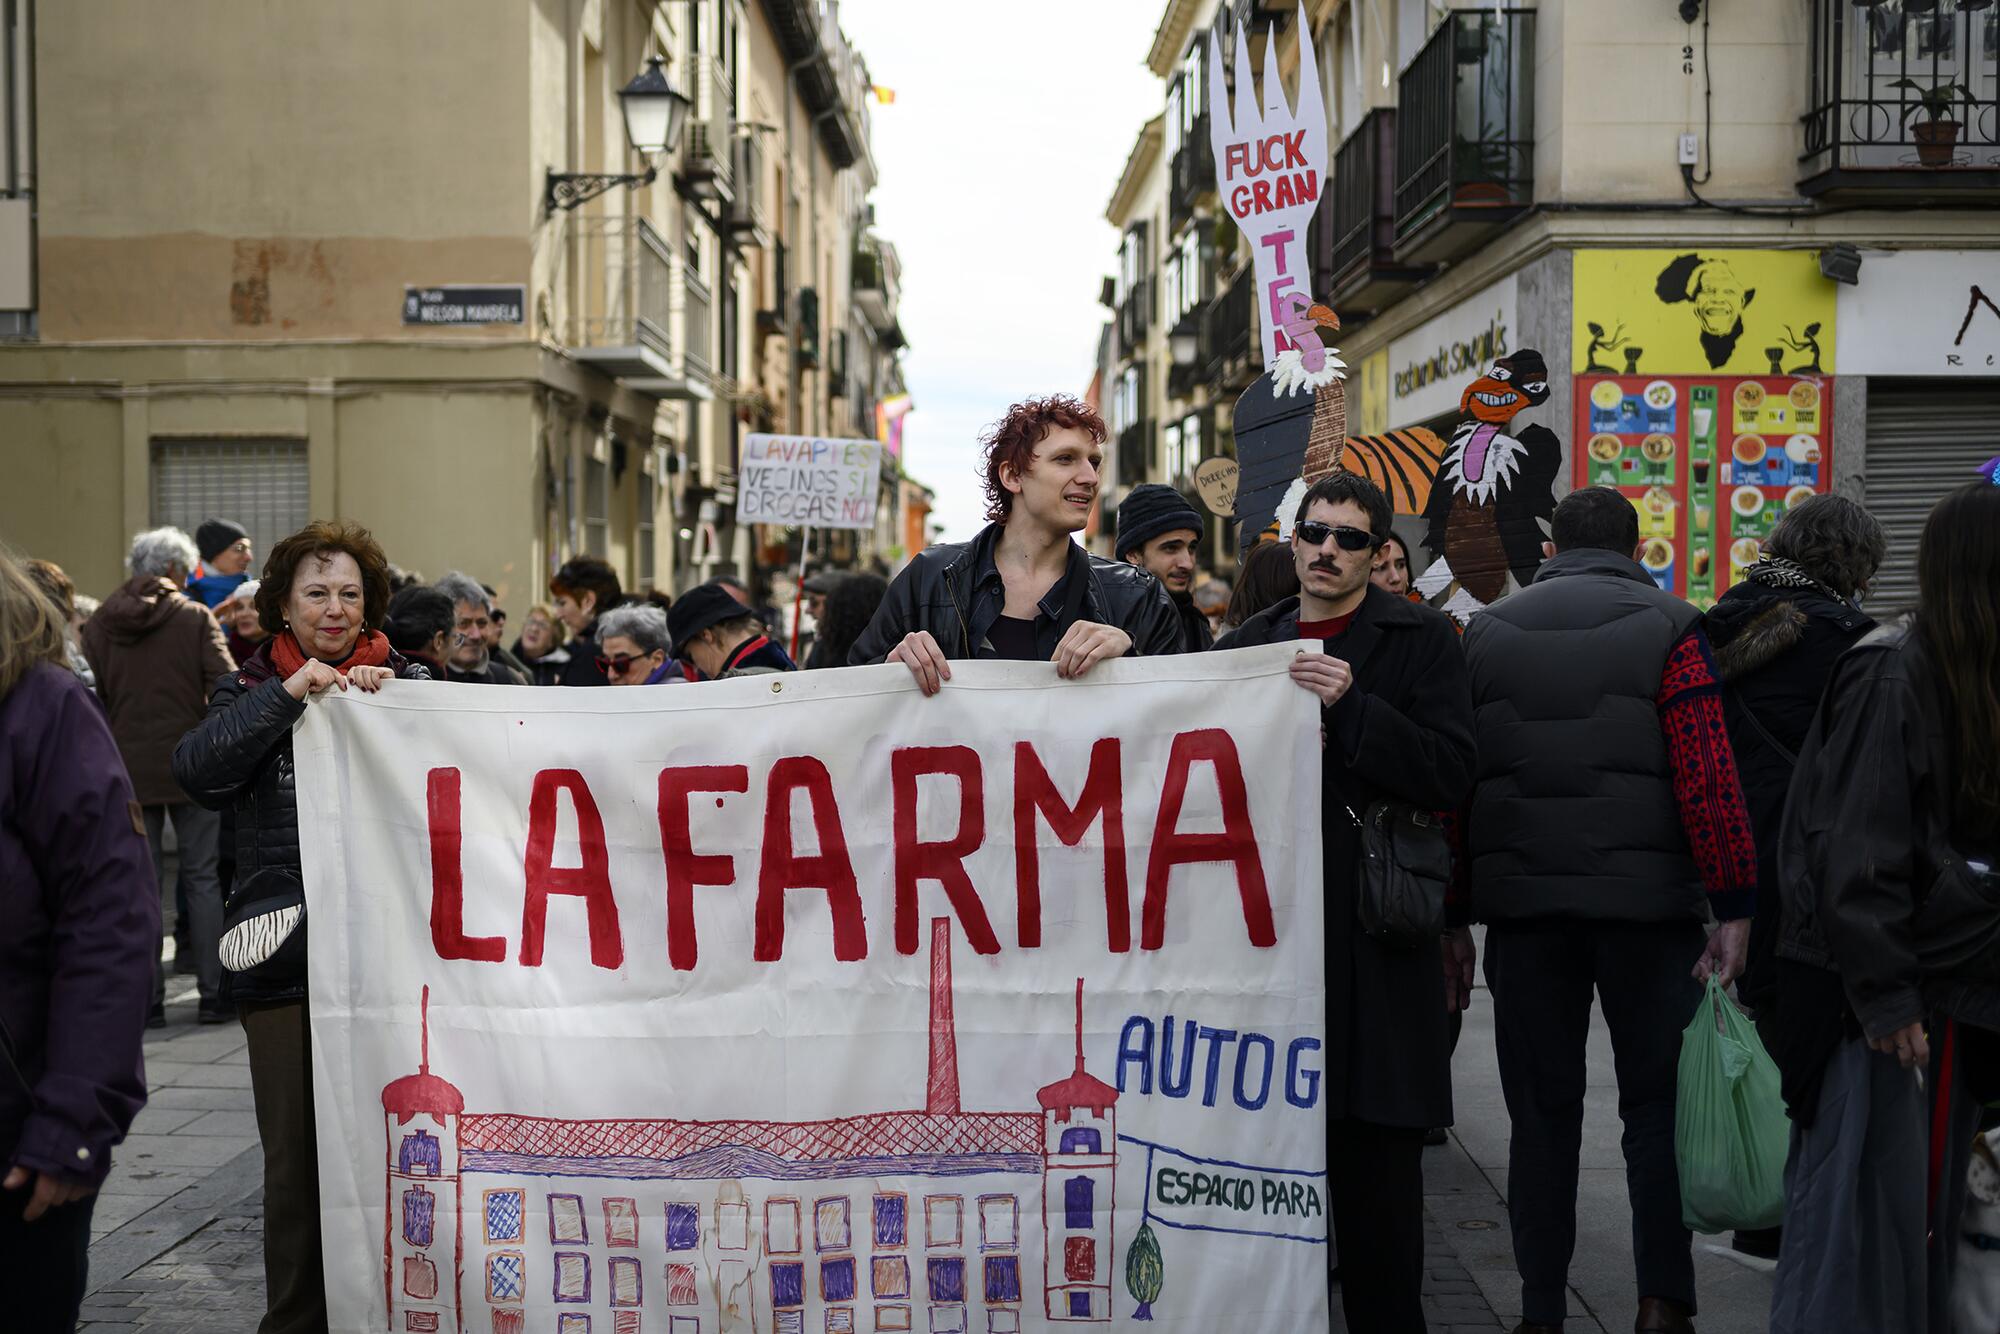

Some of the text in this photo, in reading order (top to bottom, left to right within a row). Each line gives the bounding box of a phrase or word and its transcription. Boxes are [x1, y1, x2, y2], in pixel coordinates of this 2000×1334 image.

[1226, 129, 1308, 181] FUCK
[1231, 169, 1317, 219] GRAN
[421, 304, 464, 321] NELSON
[466, 303, 519, 321] MANDELA
[750, 439, 873, 467] LAVAPIES
[747, 467, 838, 494] VECINOS
[1200, 466, 1237, 487] DERECHO
[744, 490, 869, 522] DROGAS NO
[1116, 1015, 1321, 1111] AUTOG
[1157, 1168, 1321, 1218] ESPACIO PARA
